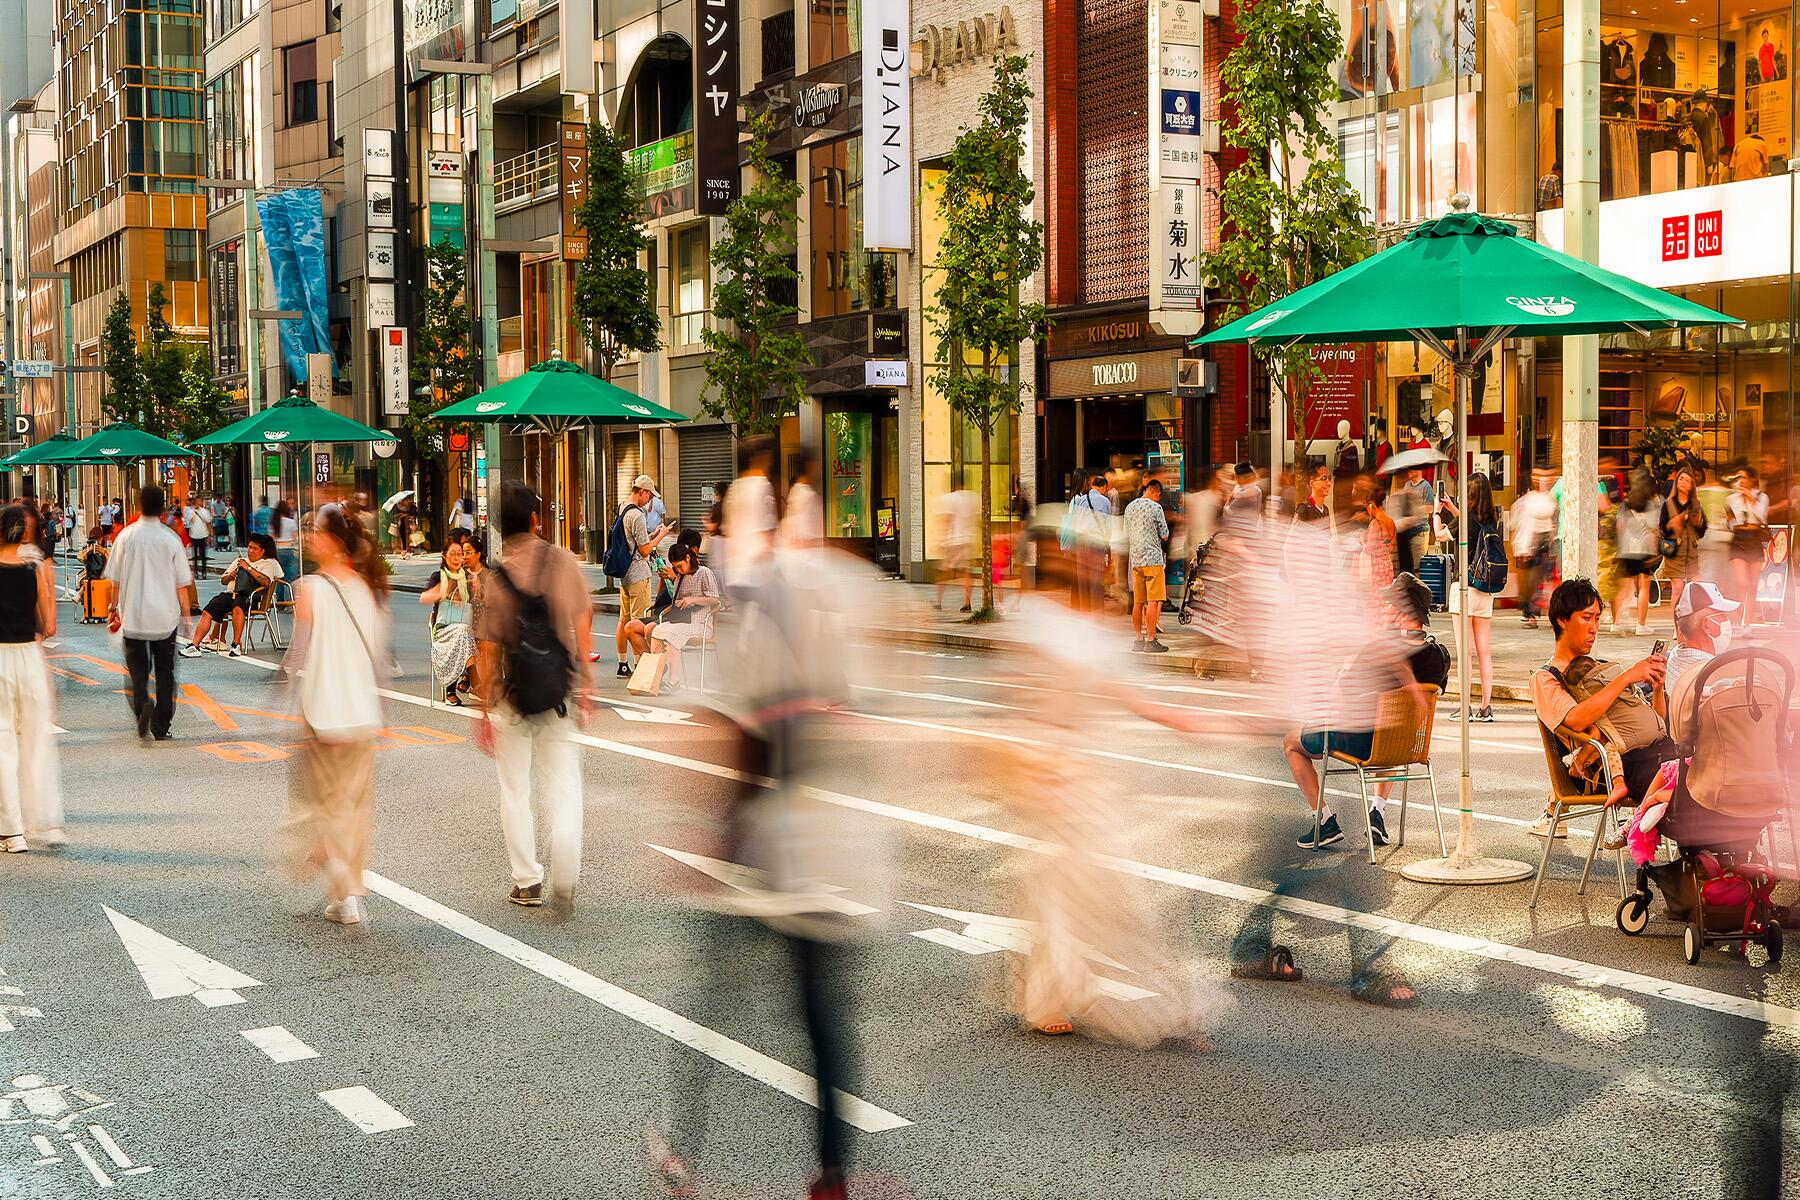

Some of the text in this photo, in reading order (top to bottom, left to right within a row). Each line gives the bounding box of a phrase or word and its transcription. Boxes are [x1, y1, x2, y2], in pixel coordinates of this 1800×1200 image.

[910, 5, 1018, 86] DIANA
[704, 0, 729, 117] シノヤ
[795, 86, 839, 127] Yoshinoya
[877, 29, 905, 176] DIANA
[812, 112, 826, 126] GINZA
[565, 130, 582, 141] 銀座
[1162, 149, 1199, 163] 三国歯科
[432, 163, 460, 171] TAT
[566, 155, 584, 225] マギー
[707, 179, 730, 189] SINCE
[707, 191, 730, 200] 1907
[1665, 221, 1686, 238] ユニ
[1698, 217, 1718, 234] UNI
[1168, 188, 1189, 280] 銀座 菊水
[1665, 239, 1686, 256] クロ
[1697, 235, 1719, 254] QLO
[368, 251, 374, 259] 6
[1505, 296, 1577, 306] GINZA
[375, 310, 394, 318] HALL
[15, 364, 50, 373] 銀座六丁目
[876, 369, 905, 379] DIANA
[1093, 362, 1136, 385] TOBACCO
[16, 416, 30, 434] D
[317, 464, 329, 473] 16
[833, 460, 861, 475] SALE
[316, 473, 328, 482] 01
[878, 518, 892, 527] SALE
